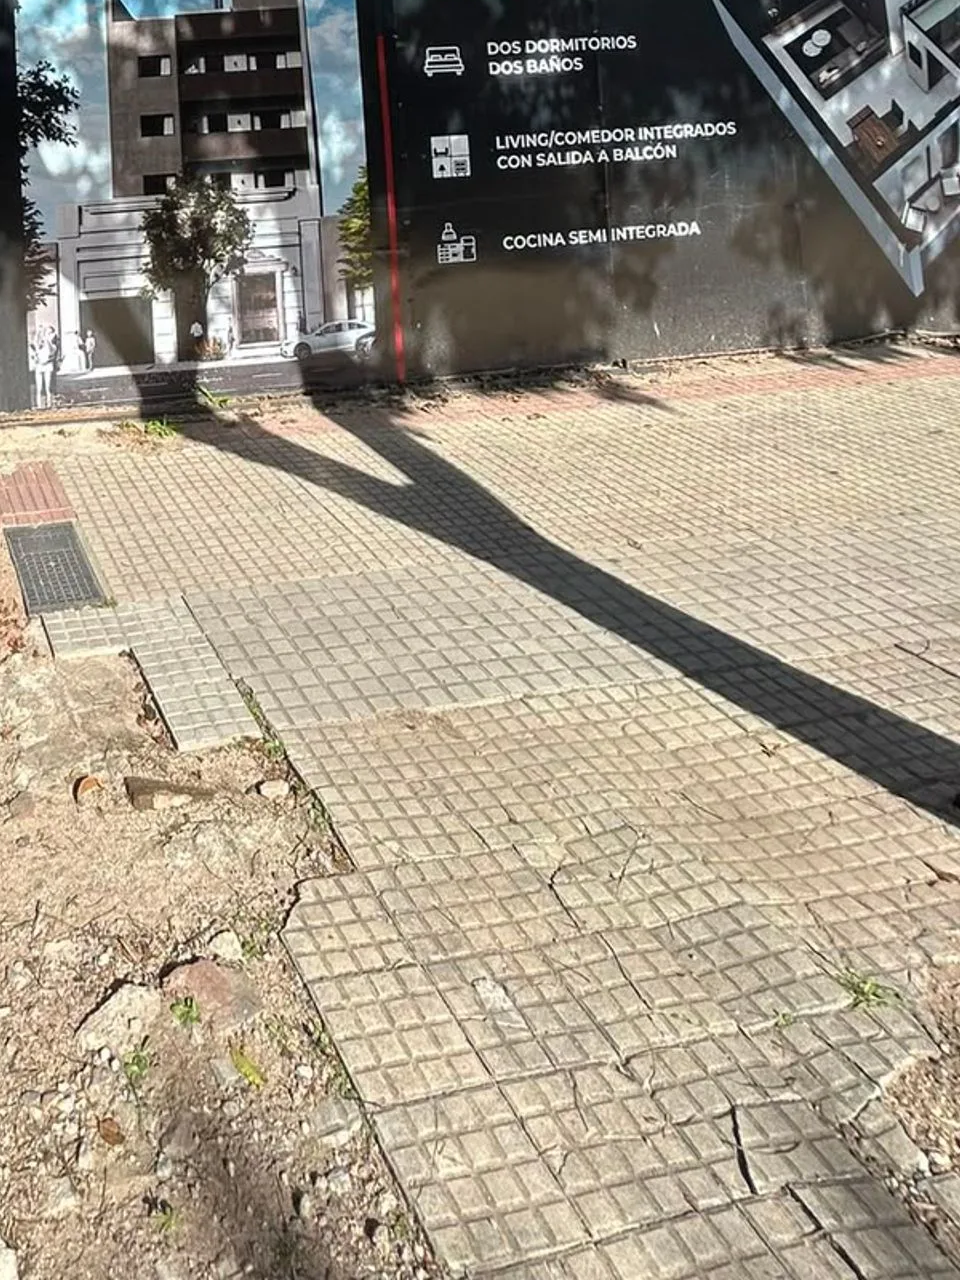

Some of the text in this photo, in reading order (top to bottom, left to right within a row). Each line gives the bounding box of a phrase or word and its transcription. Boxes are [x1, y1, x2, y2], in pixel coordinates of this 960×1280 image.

[487, 35, 637, 55] DOS DORMITORIOS
[489, 56, 583, 75] DOS BAÑOS
[496, 122, 737, 150] LIVING/COMEDOR INTEGRADOS
[497, 142, 677, 169] CON SALIDA A BALCÓN
[503, 221, 701, 250] COCINA SEMI INTEGRADA
